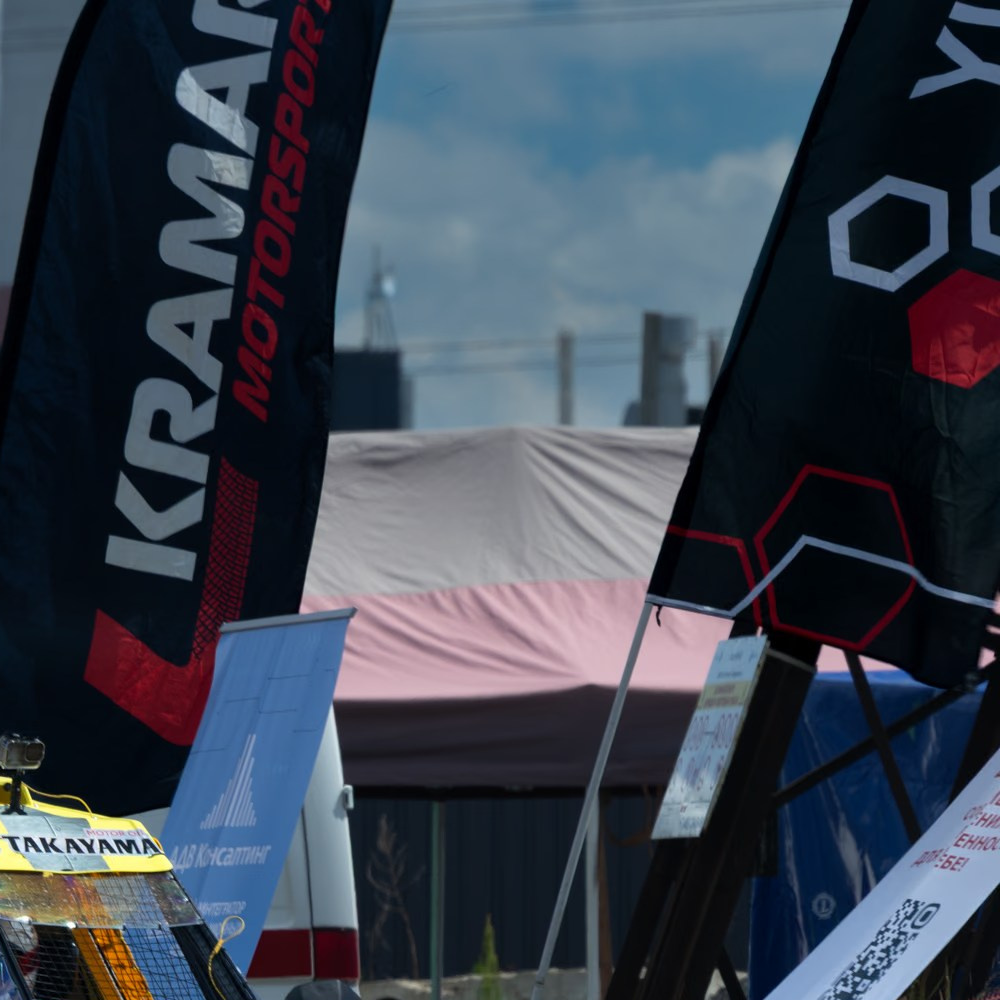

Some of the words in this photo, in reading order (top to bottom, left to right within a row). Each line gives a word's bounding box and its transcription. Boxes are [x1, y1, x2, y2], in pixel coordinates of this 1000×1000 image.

[233, 0, 332, 423] MOTORSPOR
[86, 829, 125, 837] MOTOR
[2, 835, 161, 855] TAKAYAMA
